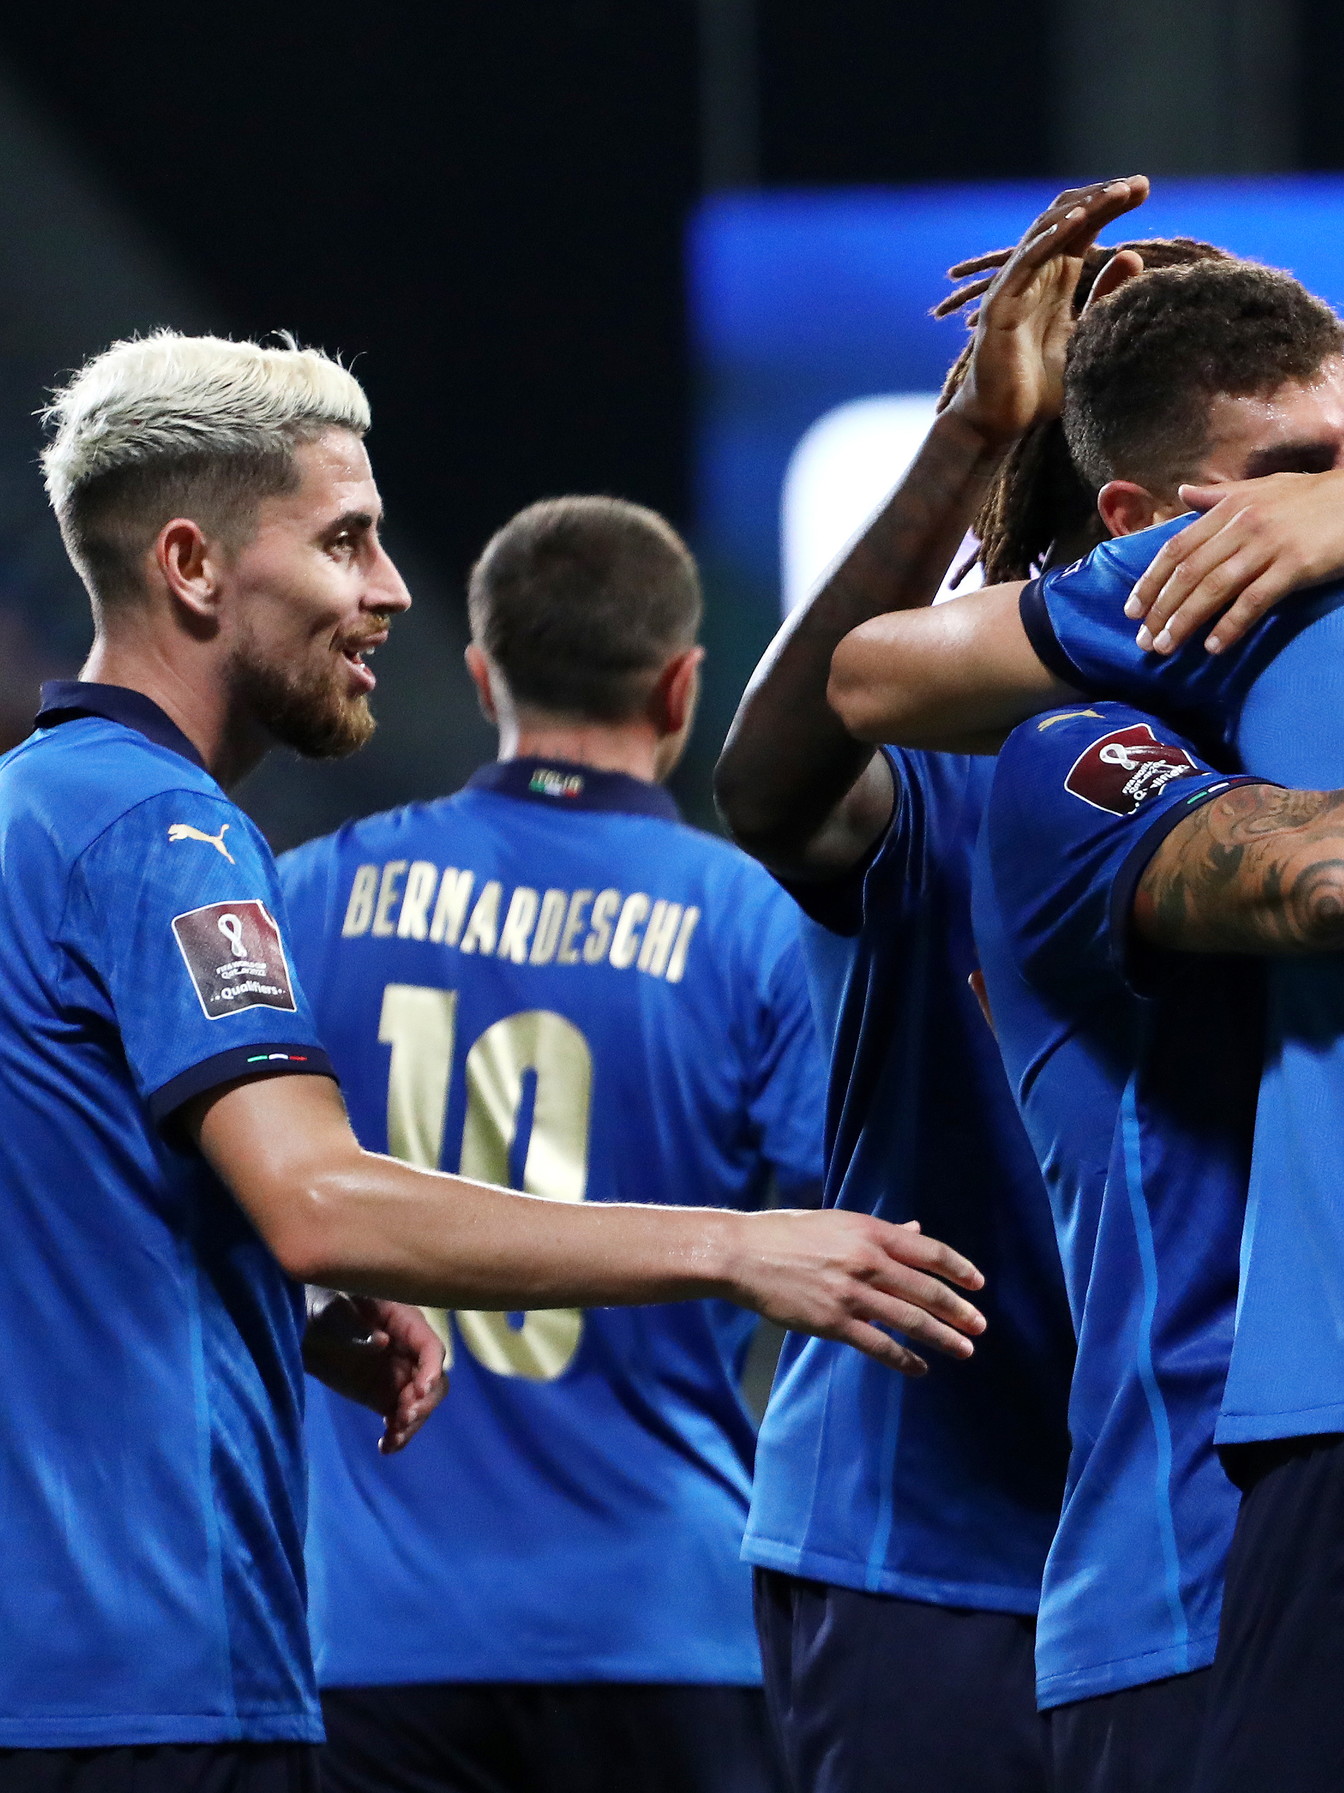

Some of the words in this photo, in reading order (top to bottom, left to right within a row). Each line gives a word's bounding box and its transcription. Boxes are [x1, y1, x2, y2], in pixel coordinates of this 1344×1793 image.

[341, 859, 701, 983] BERNARDESCHI
[221, 980, 278, 1000] Qualifiers
[378, 983, 593, 1381] 10
